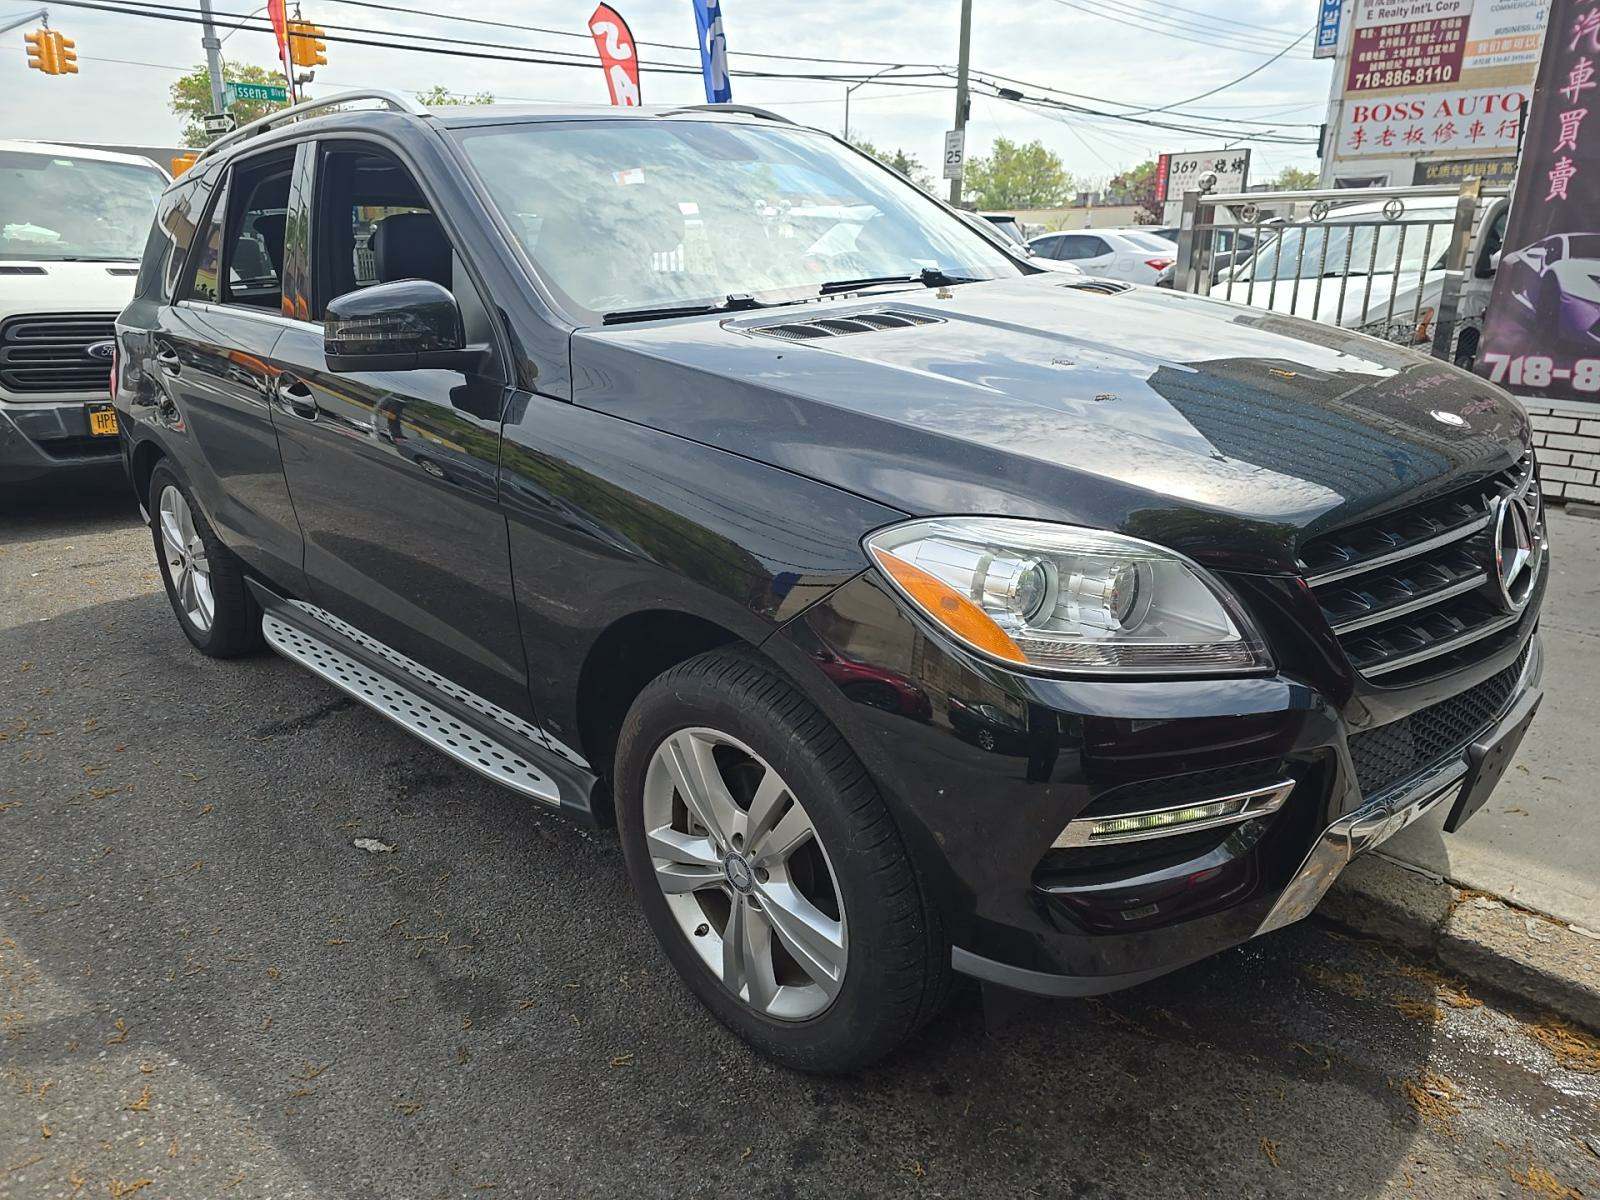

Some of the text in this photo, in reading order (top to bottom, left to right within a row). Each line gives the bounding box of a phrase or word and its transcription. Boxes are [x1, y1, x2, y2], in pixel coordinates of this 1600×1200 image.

[1366, 10, 1374, 20] E
[1378, 7, 1409, 19] Realty
[1436, 1, 1460, 12] Corp
[271, 88, 285, 97] Blvd
[1352, 92, 1526, 124] BOSS AUTO
[946, 150, 962, 164] 25
[1172, 160, 1198, 174] 369
[1484, 353, 1600, 391] 718-8
